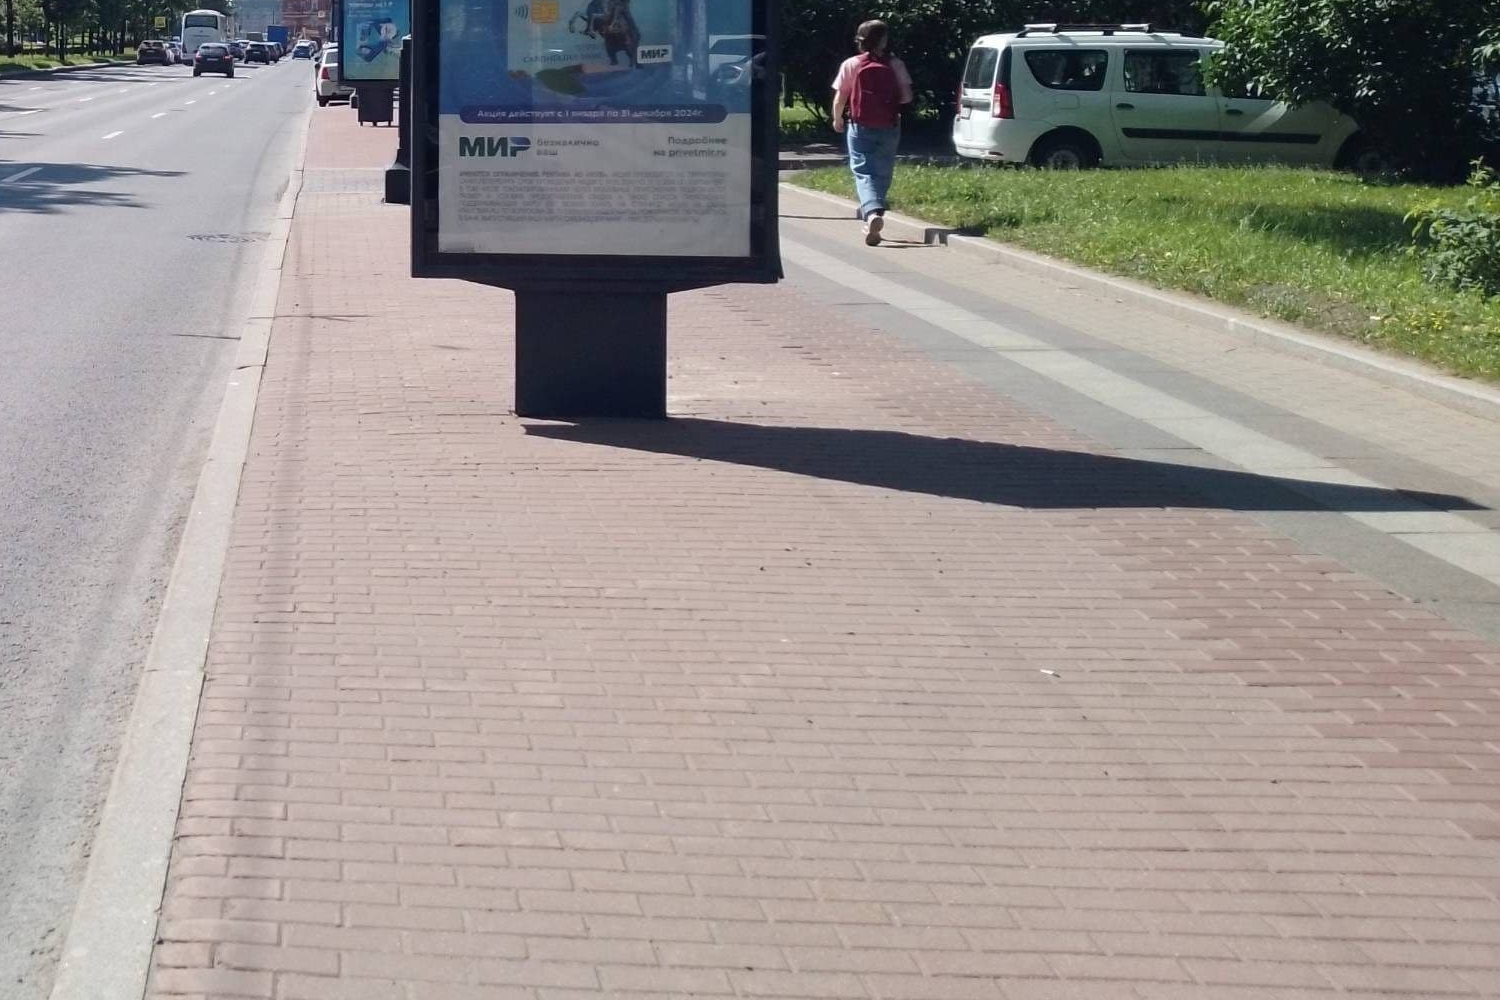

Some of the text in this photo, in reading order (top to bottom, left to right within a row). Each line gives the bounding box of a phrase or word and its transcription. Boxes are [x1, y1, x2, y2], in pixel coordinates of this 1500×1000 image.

[641, 49, 669, 60] МИР
[477, 109, 506, 119] Акция
[508, 110, 556, 119] действует
[607, 110, 619, 118] по
[668, 136, 728, 146] Подробнее
[459, 136, 531, 157] МИР
[668, 149, 727, 158] privetmir.ru
